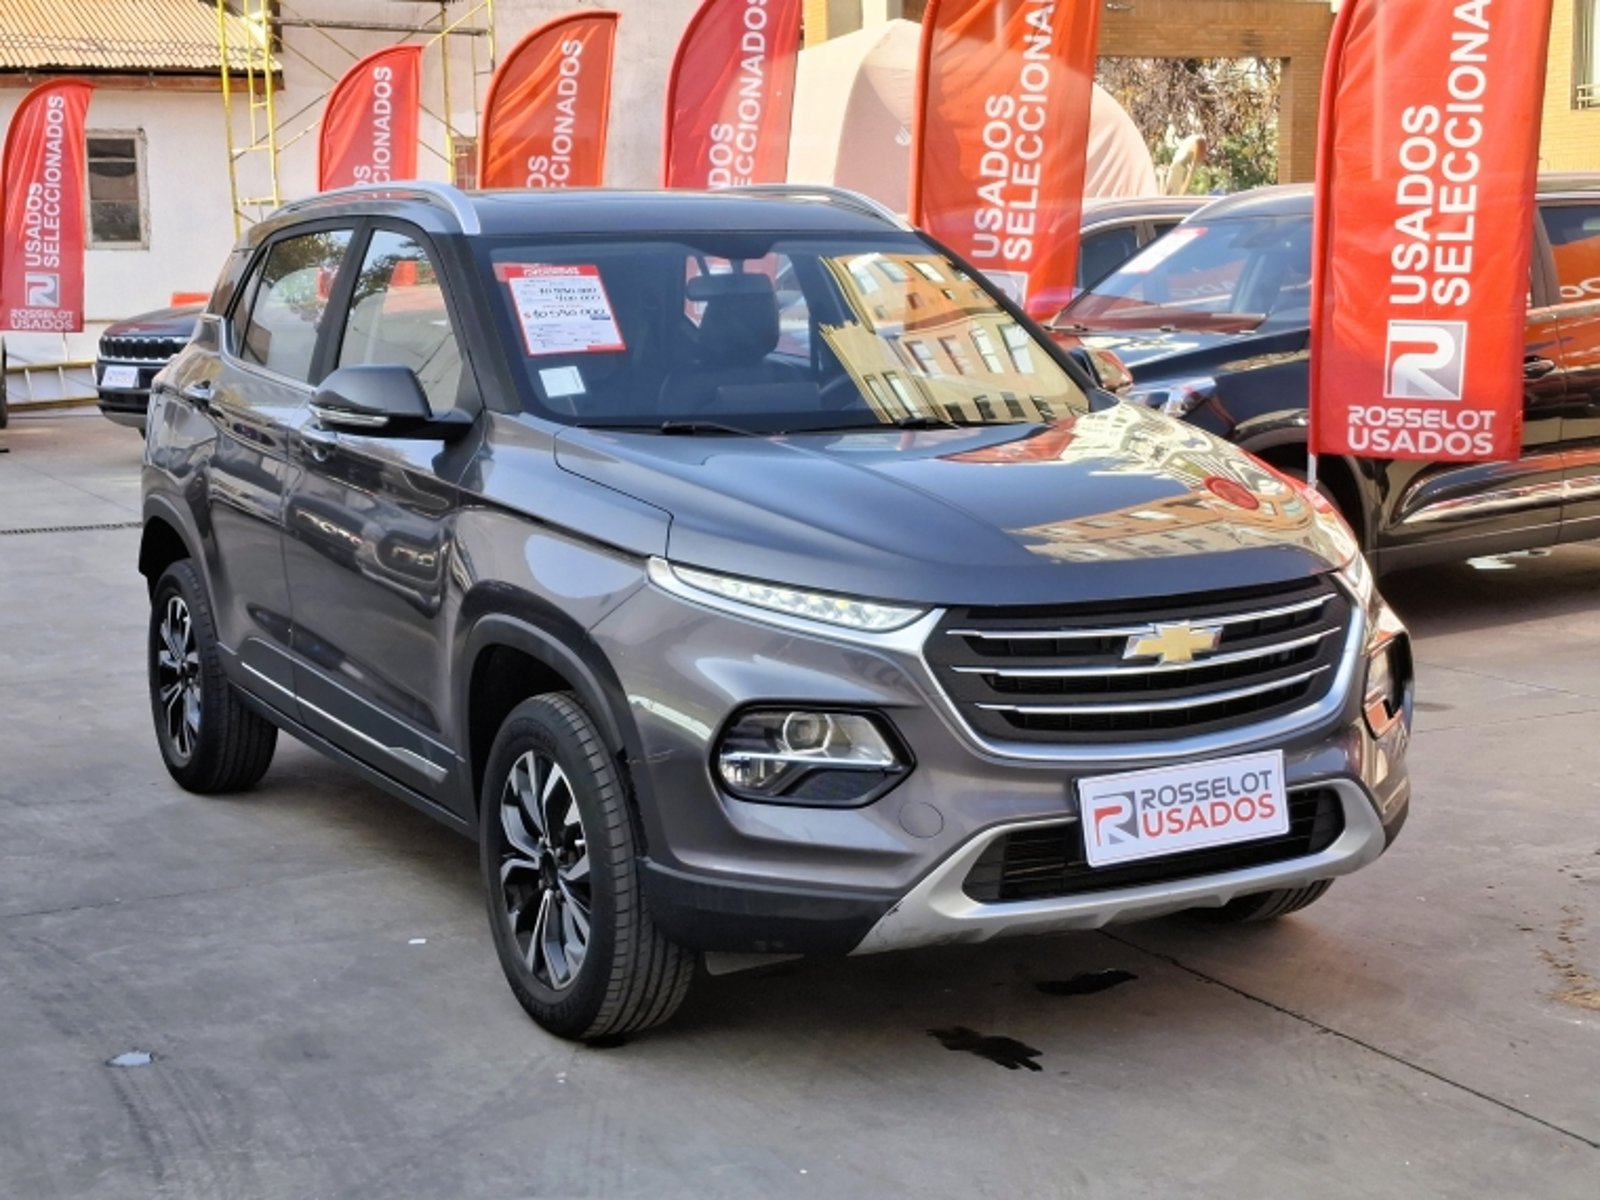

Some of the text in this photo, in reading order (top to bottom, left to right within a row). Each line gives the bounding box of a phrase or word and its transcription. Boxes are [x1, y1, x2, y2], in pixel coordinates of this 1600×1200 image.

[372, 67, 392, 185] CIONADOS
[550, 39, 584, 188] CIONADOS
[734, 0, 768, 187] ECCIONADO
[1003, 0, 1056, 262] SELECCIONA
[43, 95, 65, 268] SELECCIONADOS
[707, 123, 735, 187] DOS
[972, 94, 1015, 259] USADOS
[1389, 104, 1441, 306] USADOS
[1432, 0, 1492, 307] SELECCIONA
[25, 183, 43, 267] USADOS
[10, 319, 75, 330] USADOS
[1347, 405, 1496, 431] ROSSELOT
[1347, 426, 1495, 456] USADOS
[1140, 770, 1272, 810] ROSSELOT
[1142, 793, 1276, 838] USADOS
